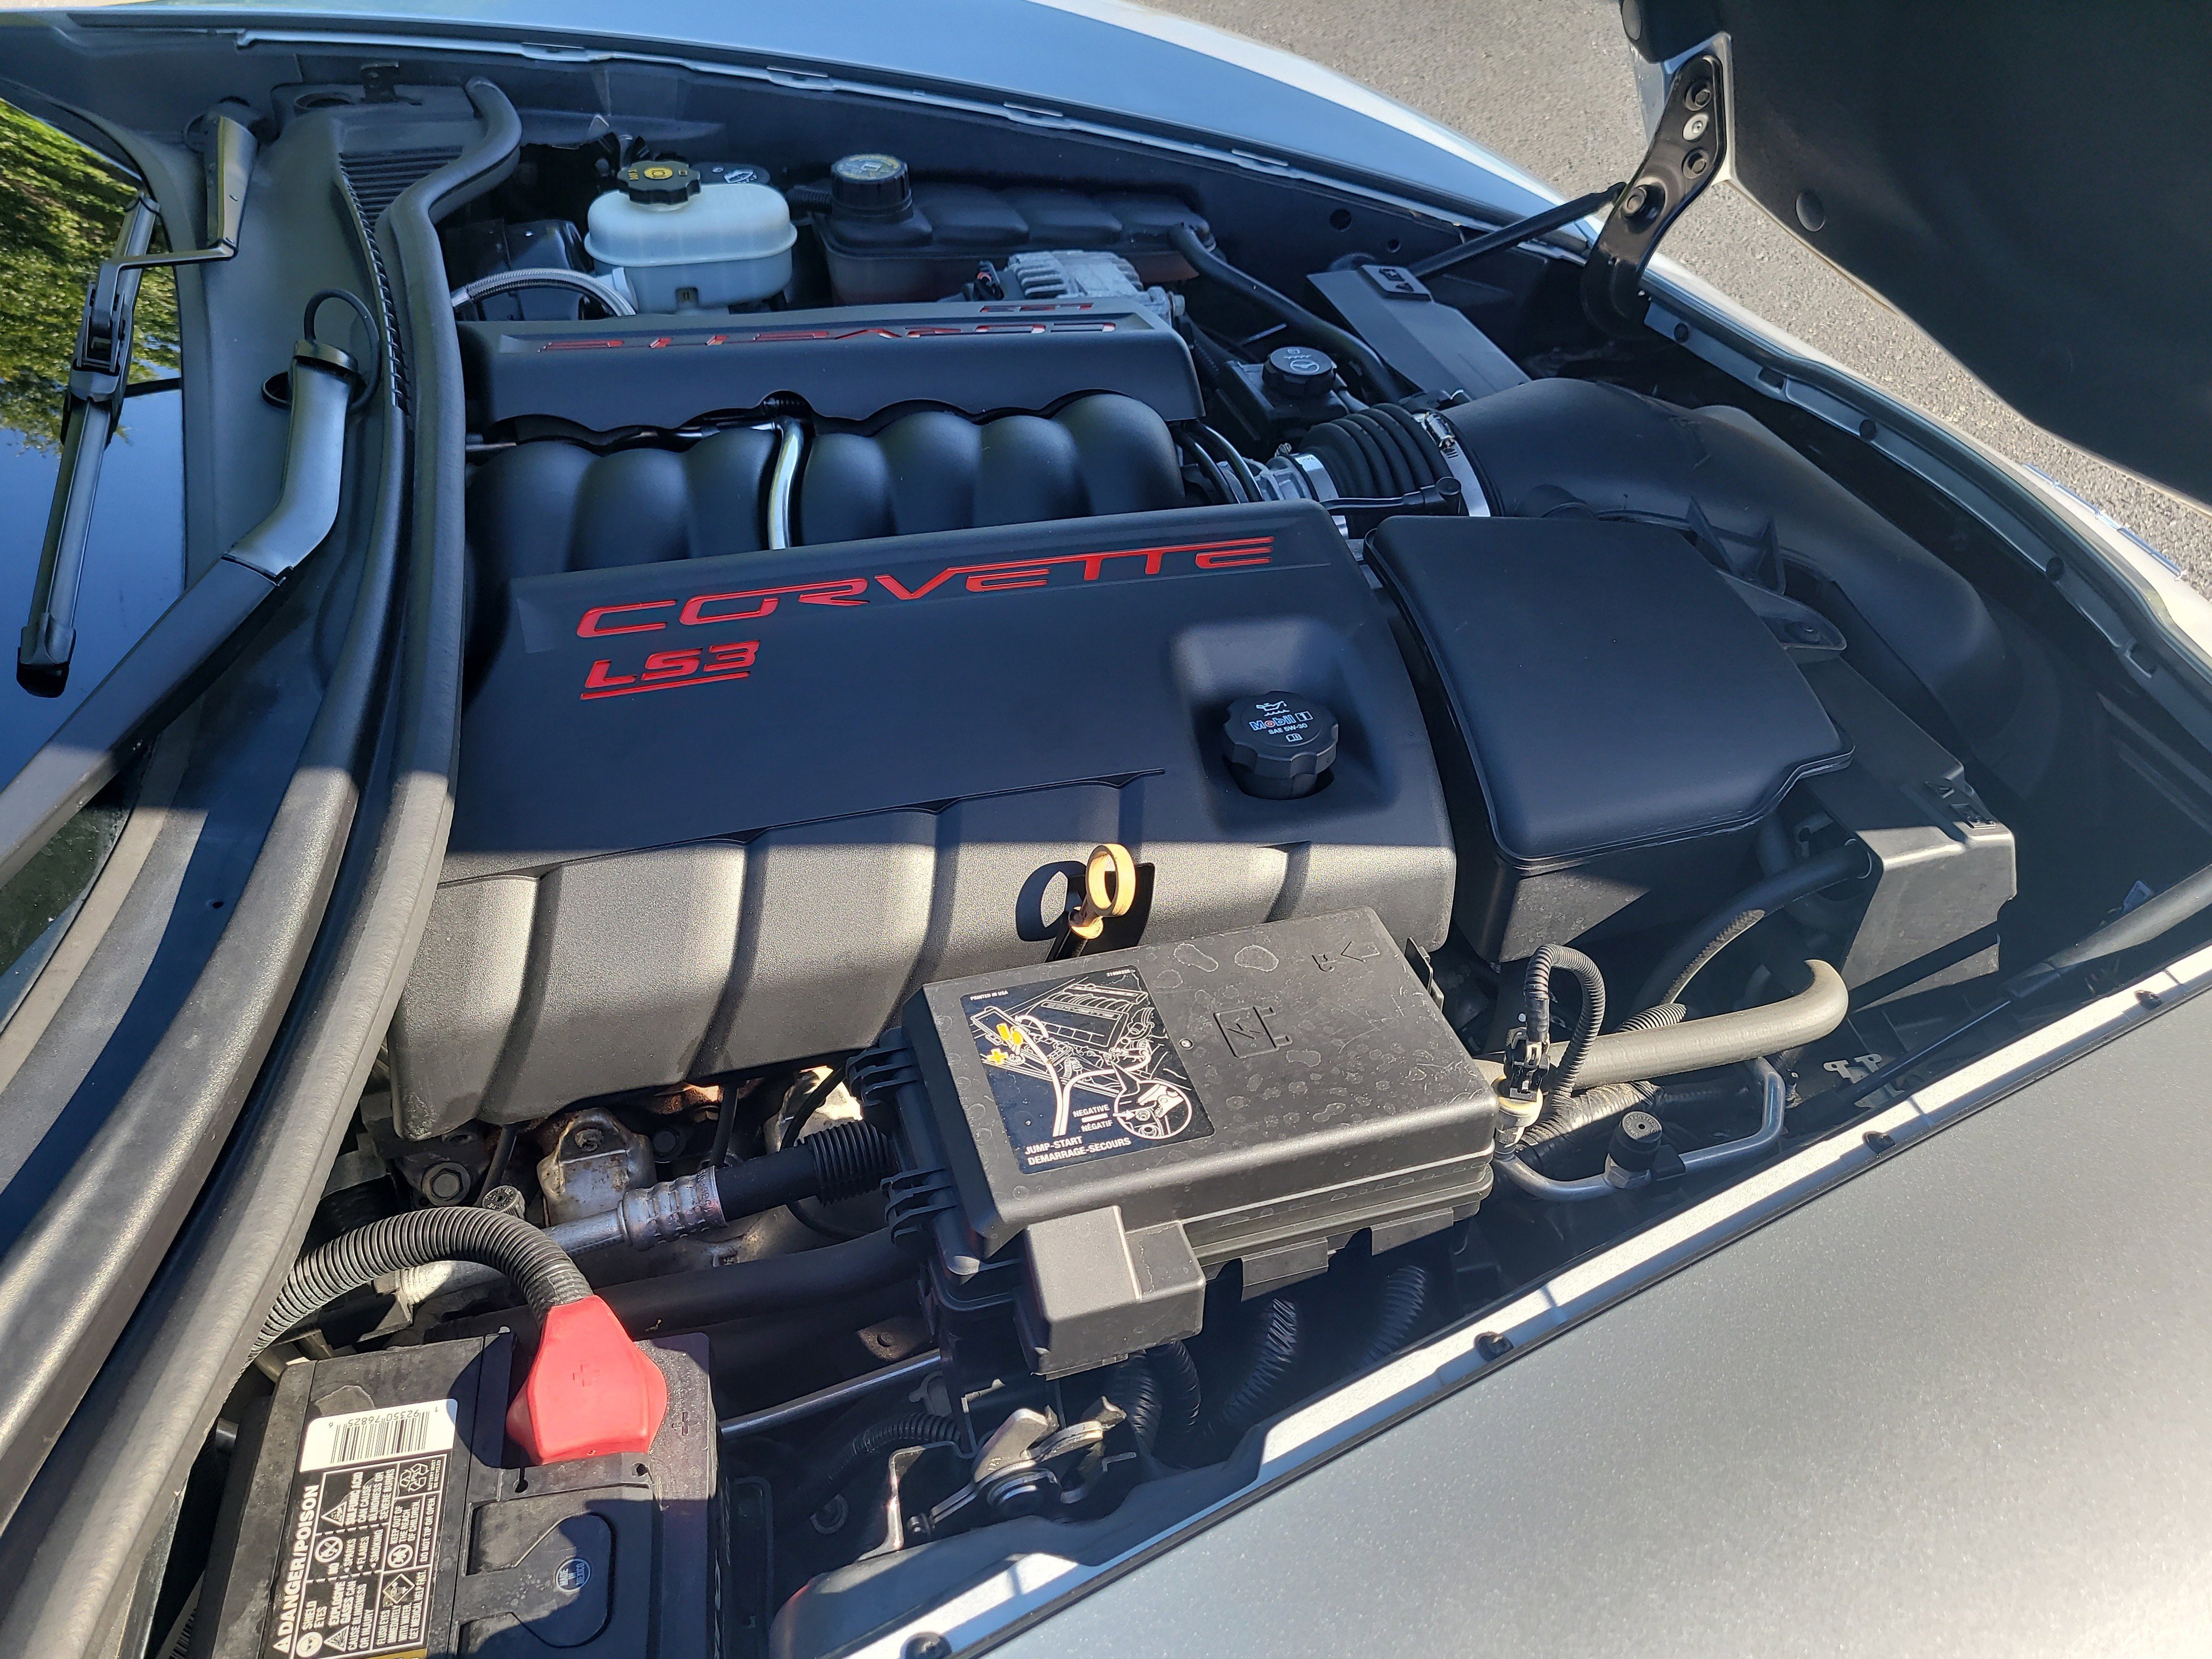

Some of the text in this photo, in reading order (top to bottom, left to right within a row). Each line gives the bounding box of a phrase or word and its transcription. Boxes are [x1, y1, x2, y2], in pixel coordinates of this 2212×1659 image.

[577, 536, 1274, 638] CORVETTE
[583, 639, 760, 690] LS3
[1249, 714, 1296, 731] Mobil
[1284, 723, 1308, 732] 5W-30
[1073, 1104, 1110, 1118] NEGATIVE
[1081, 1120, 1113, 1132] NÉGATIF
[1025, 1136, 1083, 1155] JUMP-START
[1027, 1137, 1132, 1166] DEMARRAGE-SECOURS
[348, 1415, 381, 1427] 76825
[386, 1409, 420, 1422] 92350
[379, 1468, 396, 1520] SEVERE BURNS
[410, 1472, 417, 1481] Pb
[345, 1471, 364, 1525] SULFURIC ACID
[357, 1483, 372, 1522] CAN CAUSE
[368, 1471, 384, 1521] BLINDNESS OR
[390, 1505, 403, 1544] KEEP OUT OF
[398, 1508, 411, 1543] THE REACH
[407, 1499, 421, 1541] OF CHILDREN.
[420, 1495, 436, 1562] DO NOT TIP OR OPEN.
[279, 1484, 320, 1635] DANGER/POISON
[342, 1538, 357, 1566] SPARKS
[357, 1536, 370, 1564] FLAMES
[369, 1528, 383, 1562] SMOKING
[327, 1561, 340, 1575] NO
[560, 1568, 568, 1586] MADE
[576, 1563, 585, 1585] MEXICO
[301, 1600, 317, 1630] SHIELD
[313, 1605, 328, 1628] EYES
[328, 1581, 346, 1626] EXPLOSIVE
[340, 1580, 357, 1624] GASES CAN
[347, 1583, 367, 1650] CAUSE BLINDNESS
[409, 1569, 427, 1639] GET MEDICAL HELP FAST.
[359, 1608, 374, 1649] OR INJURY
[376, 1609, 391, 1645] FLUSH EYES
[387, 1604, 402, 1643] IMMEDIATELY
[398, 1601, 412, 1641] WITH WATER.
